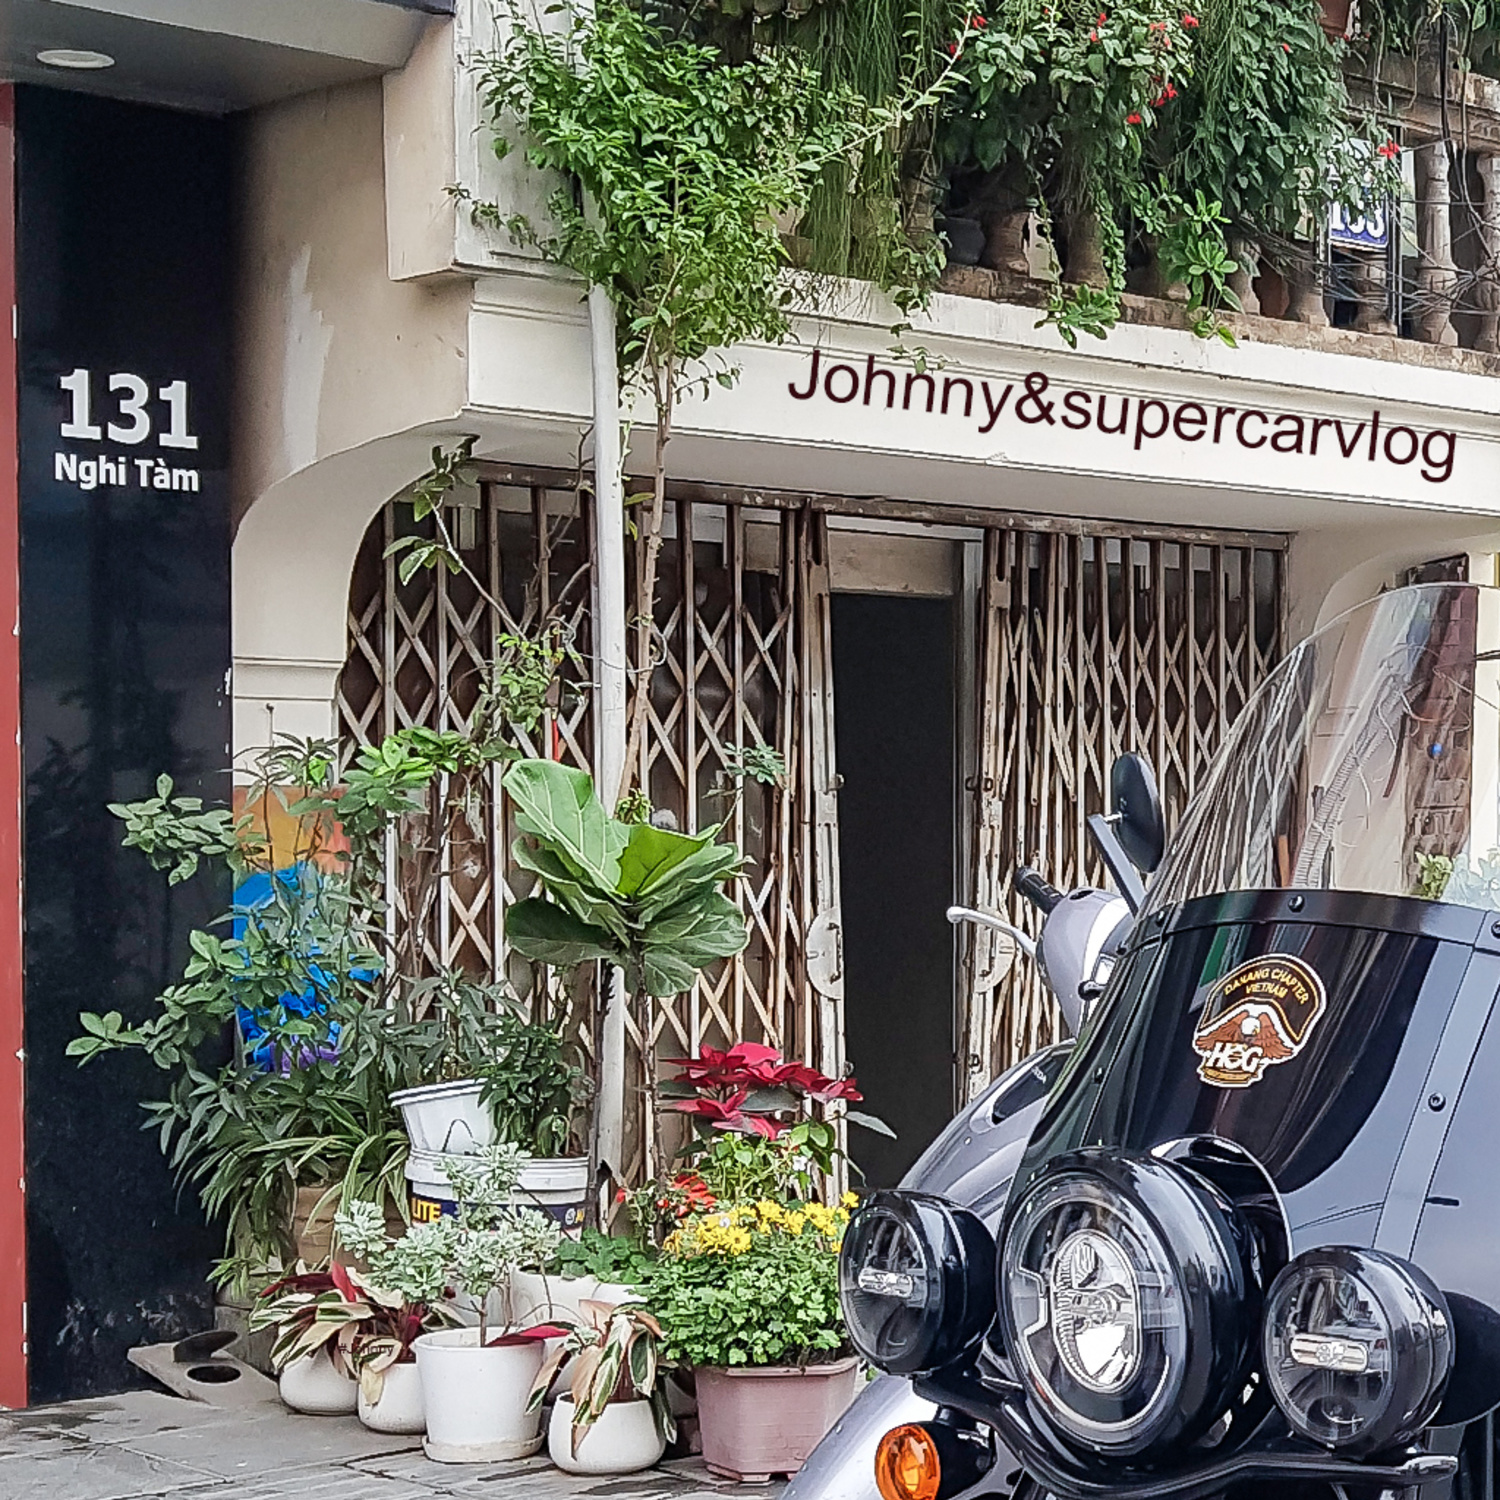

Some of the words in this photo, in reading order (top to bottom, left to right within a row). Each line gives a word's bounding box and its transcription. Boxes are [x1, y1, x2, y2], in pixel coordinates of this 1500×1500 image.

[59, 368, 199, 450] 131
[54, 452, 127, 490] Nghi
[134, 458, 199, 492] Tàm
[1246, 981, 1289, 998] VIETNAM
[1270, 967, 1309, 1005] CHAPTER
